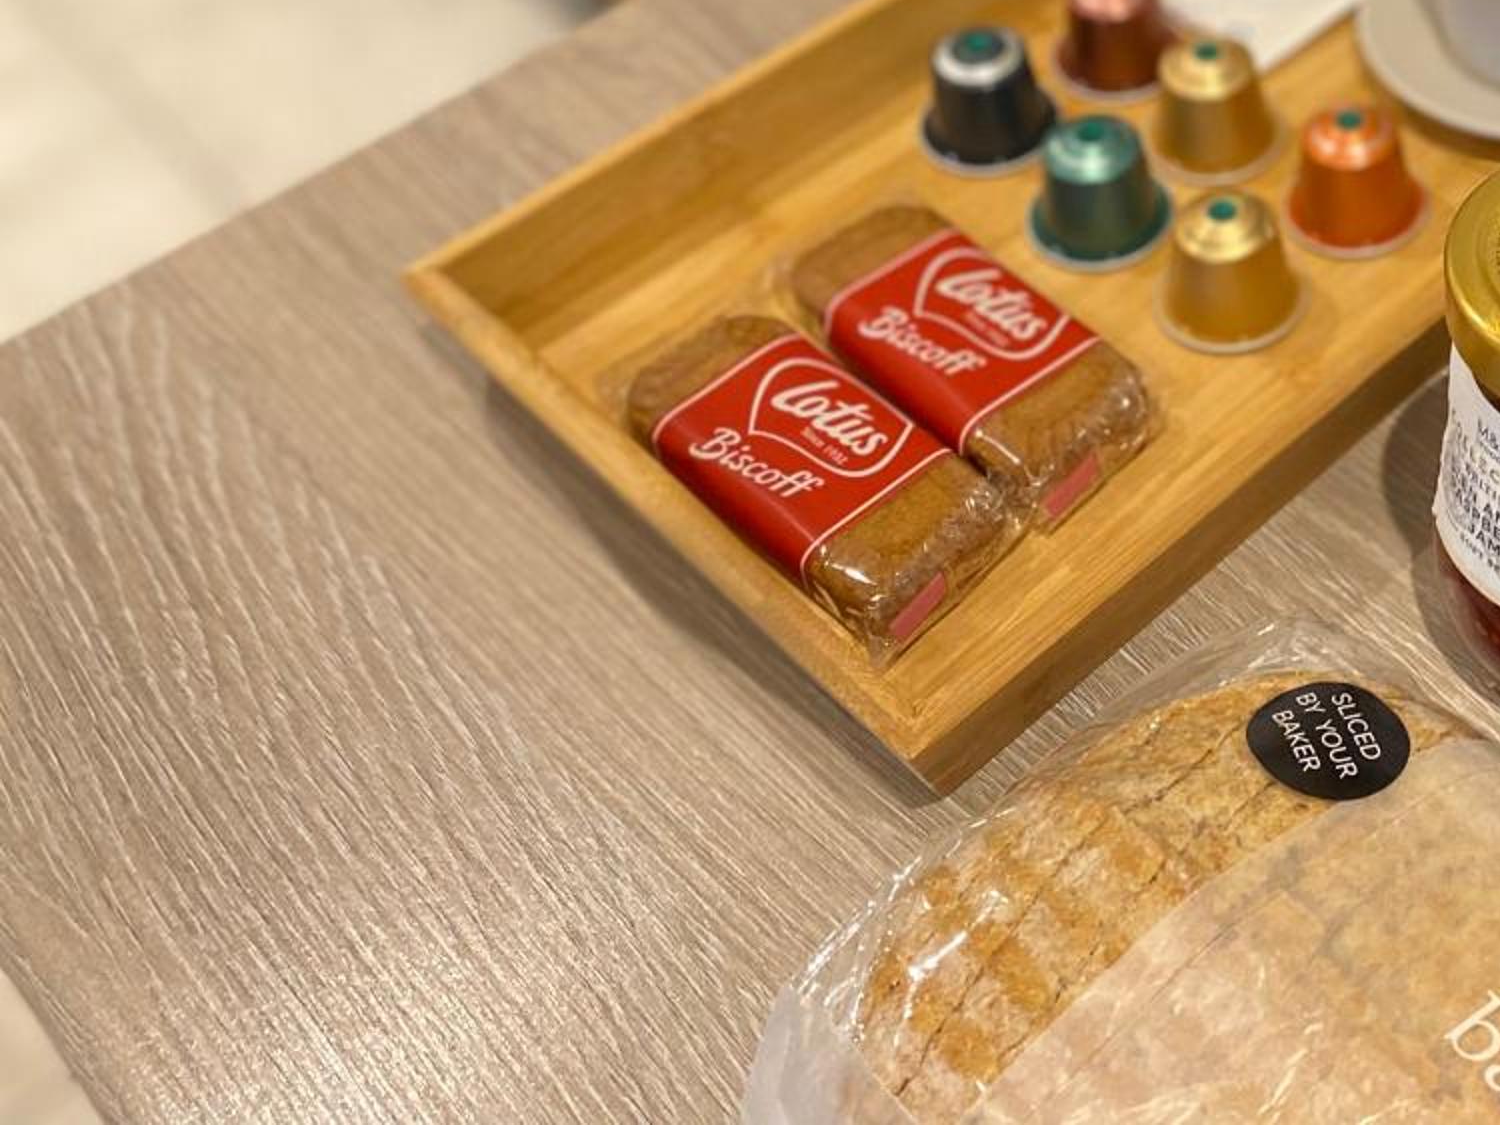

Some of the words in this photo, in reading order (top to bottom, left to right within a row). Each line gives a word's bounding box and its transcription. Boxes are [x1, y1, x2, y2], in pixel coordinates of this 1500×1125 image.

[934, 266, 1048, 341] Lotus
[857, 305, 988, 377] Biscoff
[770, 379, 889, 456] Lotus
[688, 427, 825, 498] Biscoff
[1272, 710, 1322, 772] BAKER
[1296, 692, 1327, 714] BY
[1315, 719, 1358, 779] YOUR
[1331, 692, 1381, 761] SLICED
